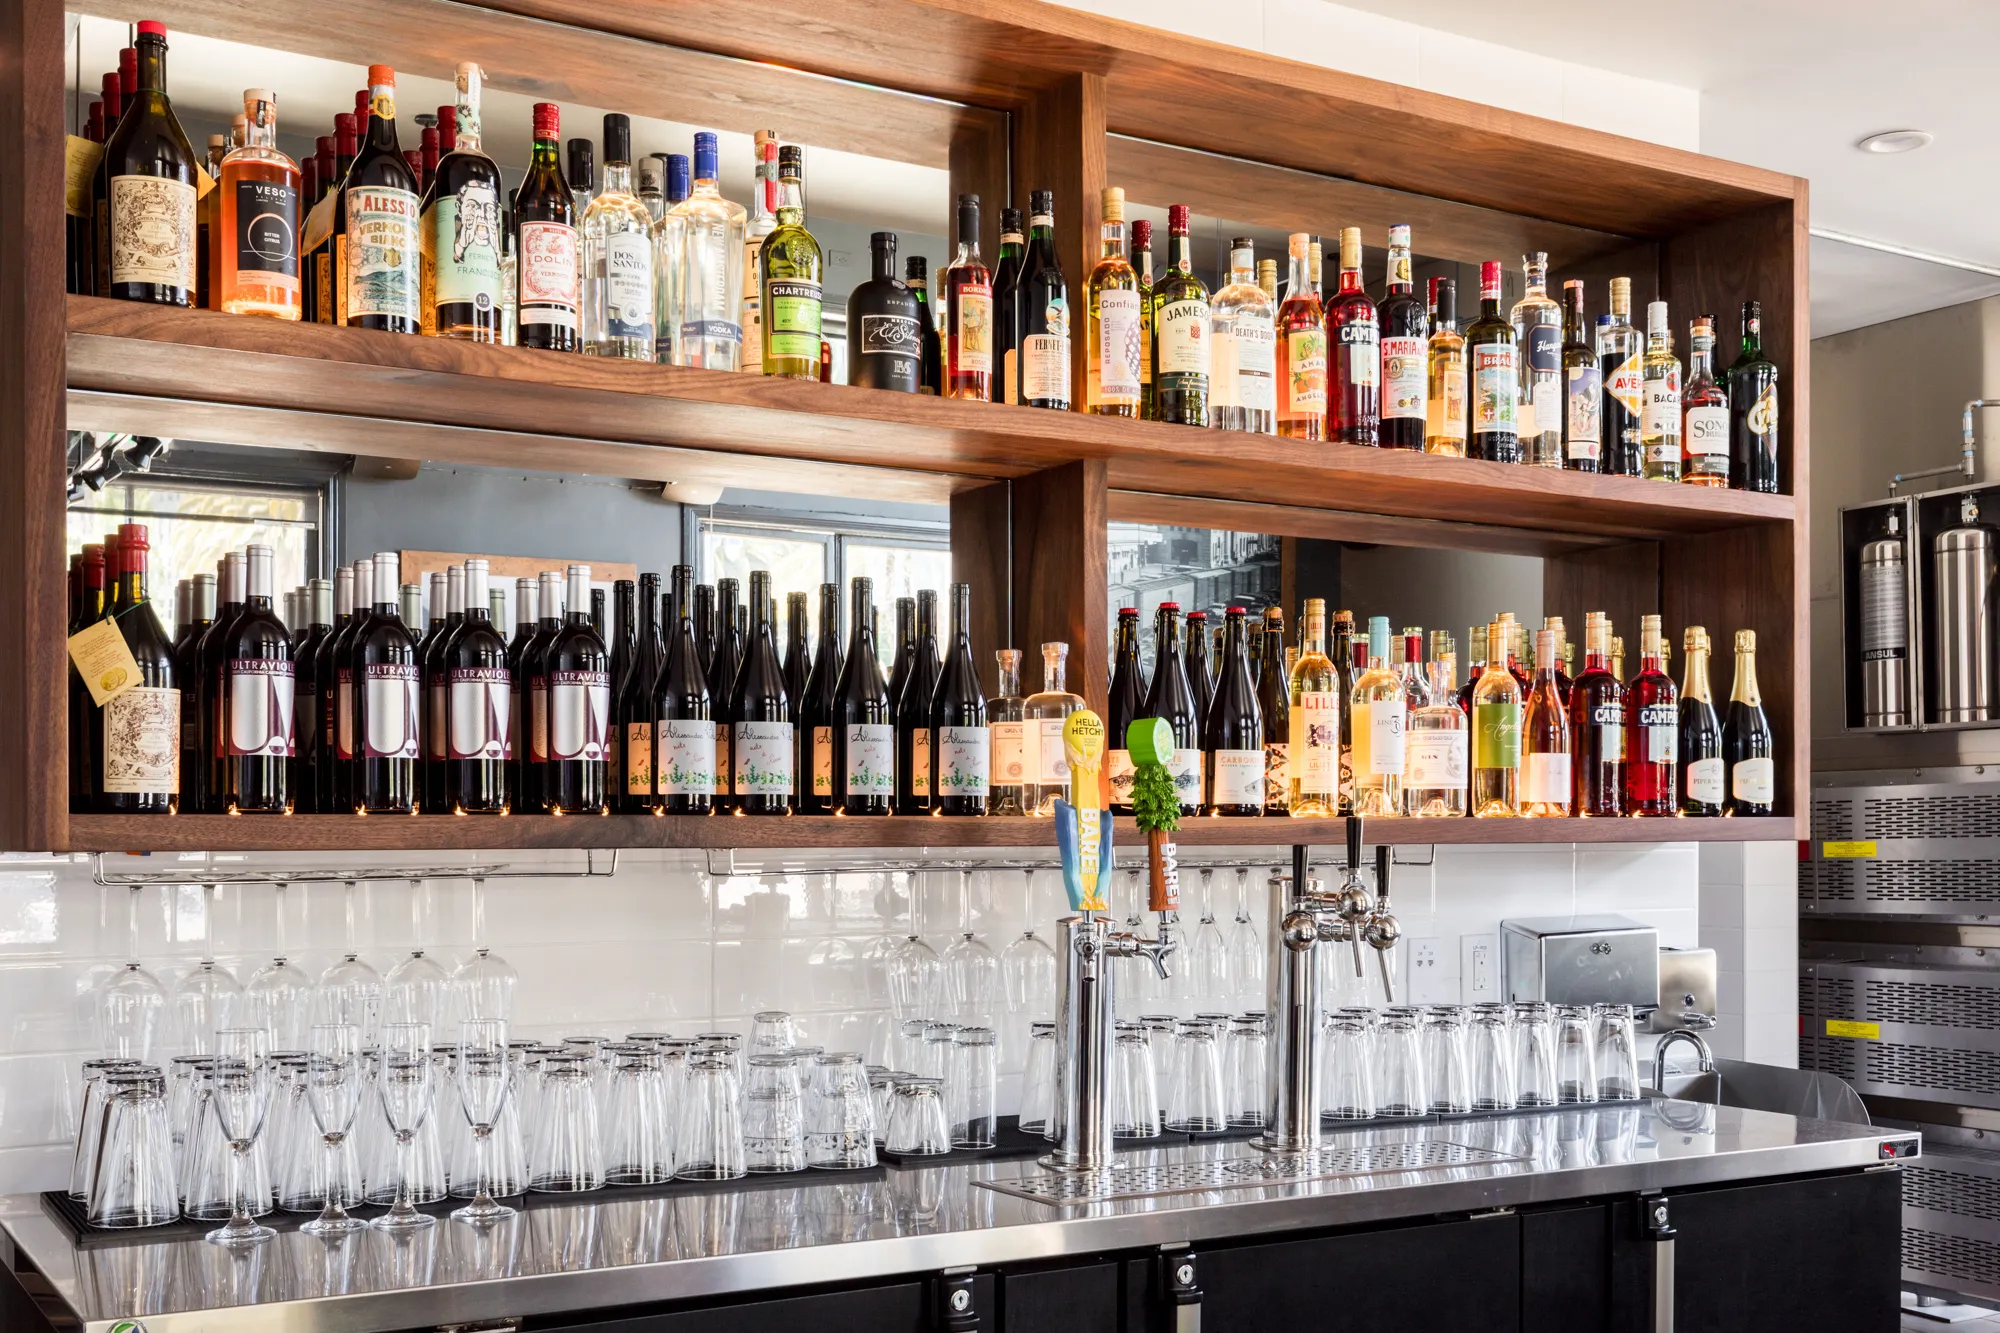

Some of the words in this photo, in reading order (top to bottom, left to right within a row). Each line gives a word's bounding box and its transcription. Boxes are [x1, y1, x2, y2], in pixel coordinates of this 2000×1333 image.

[256, 186, 286, 198] VESO
[364, 195, 415, 218] ALESSIO
[534, 256, 572, 267] DOLIN
[614, 252, 634, 260] DOS
[613, 260, 648, 271] SANTOS
[478, 296, 488, 305] 12
[708, 325, 732, 335] VODKA
[1235, 327, 1259, 339] DEATH'S
[1866, 649, 1896, 660] ANSUL
[1075, 718, 1102, 728] HELLA
[1080, 808, 1100, 868] BARE
[1160, 843, 1180, 897] BARE
